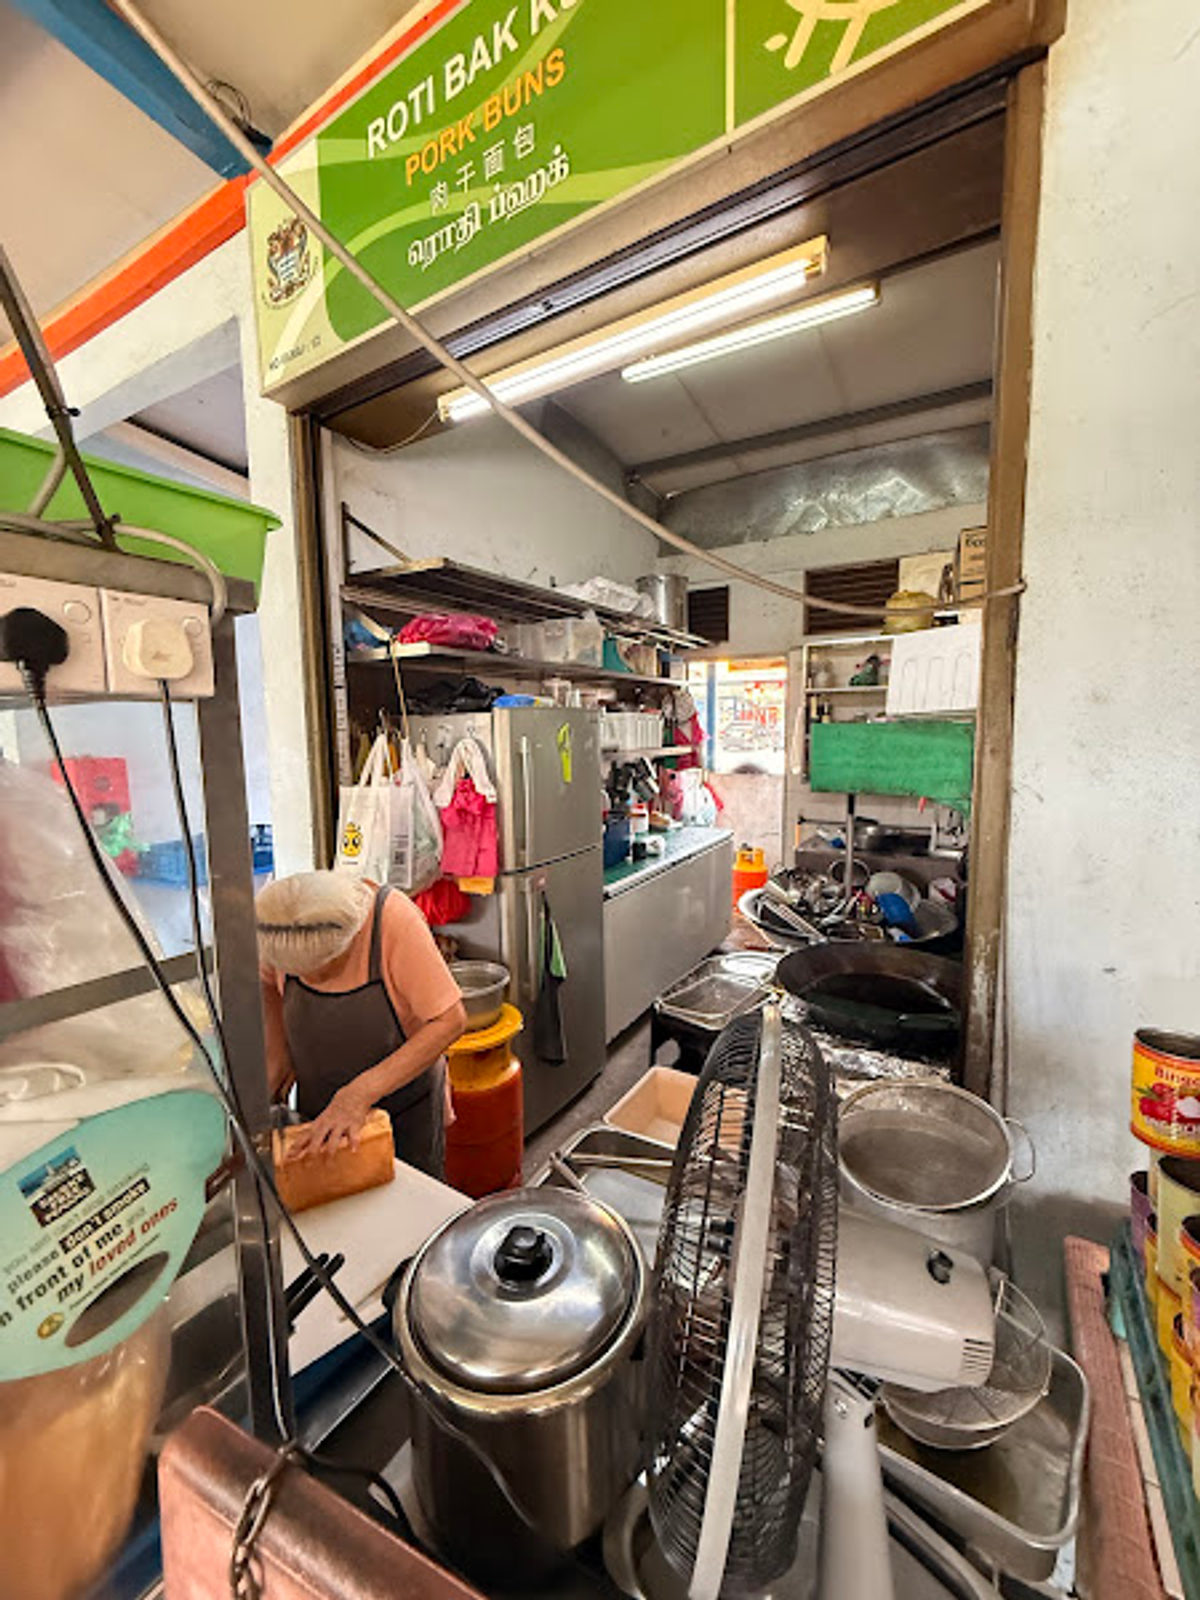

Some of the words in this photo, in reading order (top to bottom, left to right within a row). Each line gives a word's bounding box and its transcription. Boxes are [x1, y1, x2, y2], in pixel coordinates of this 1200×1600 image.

[366, 75, 436, 160] ROTI
[444, 5, 519, 104] BAK
[529, 0, 577, 36] K
[405, 112, 477, 187] PORK
[483, 47, 567, 133] BUNS
[7, 1249, 60, 1296] please
[66, 1214, 102, 1249] don't
[16, 1265, 68, 1311] front
[72, 1245, 91, 1269] of
[95, 1222, 123, 1250] me
[57, 1271, 84, 1304] my
[88, 1227, 137, 1278] loved
[140, 1196, 178, 1235] ones
